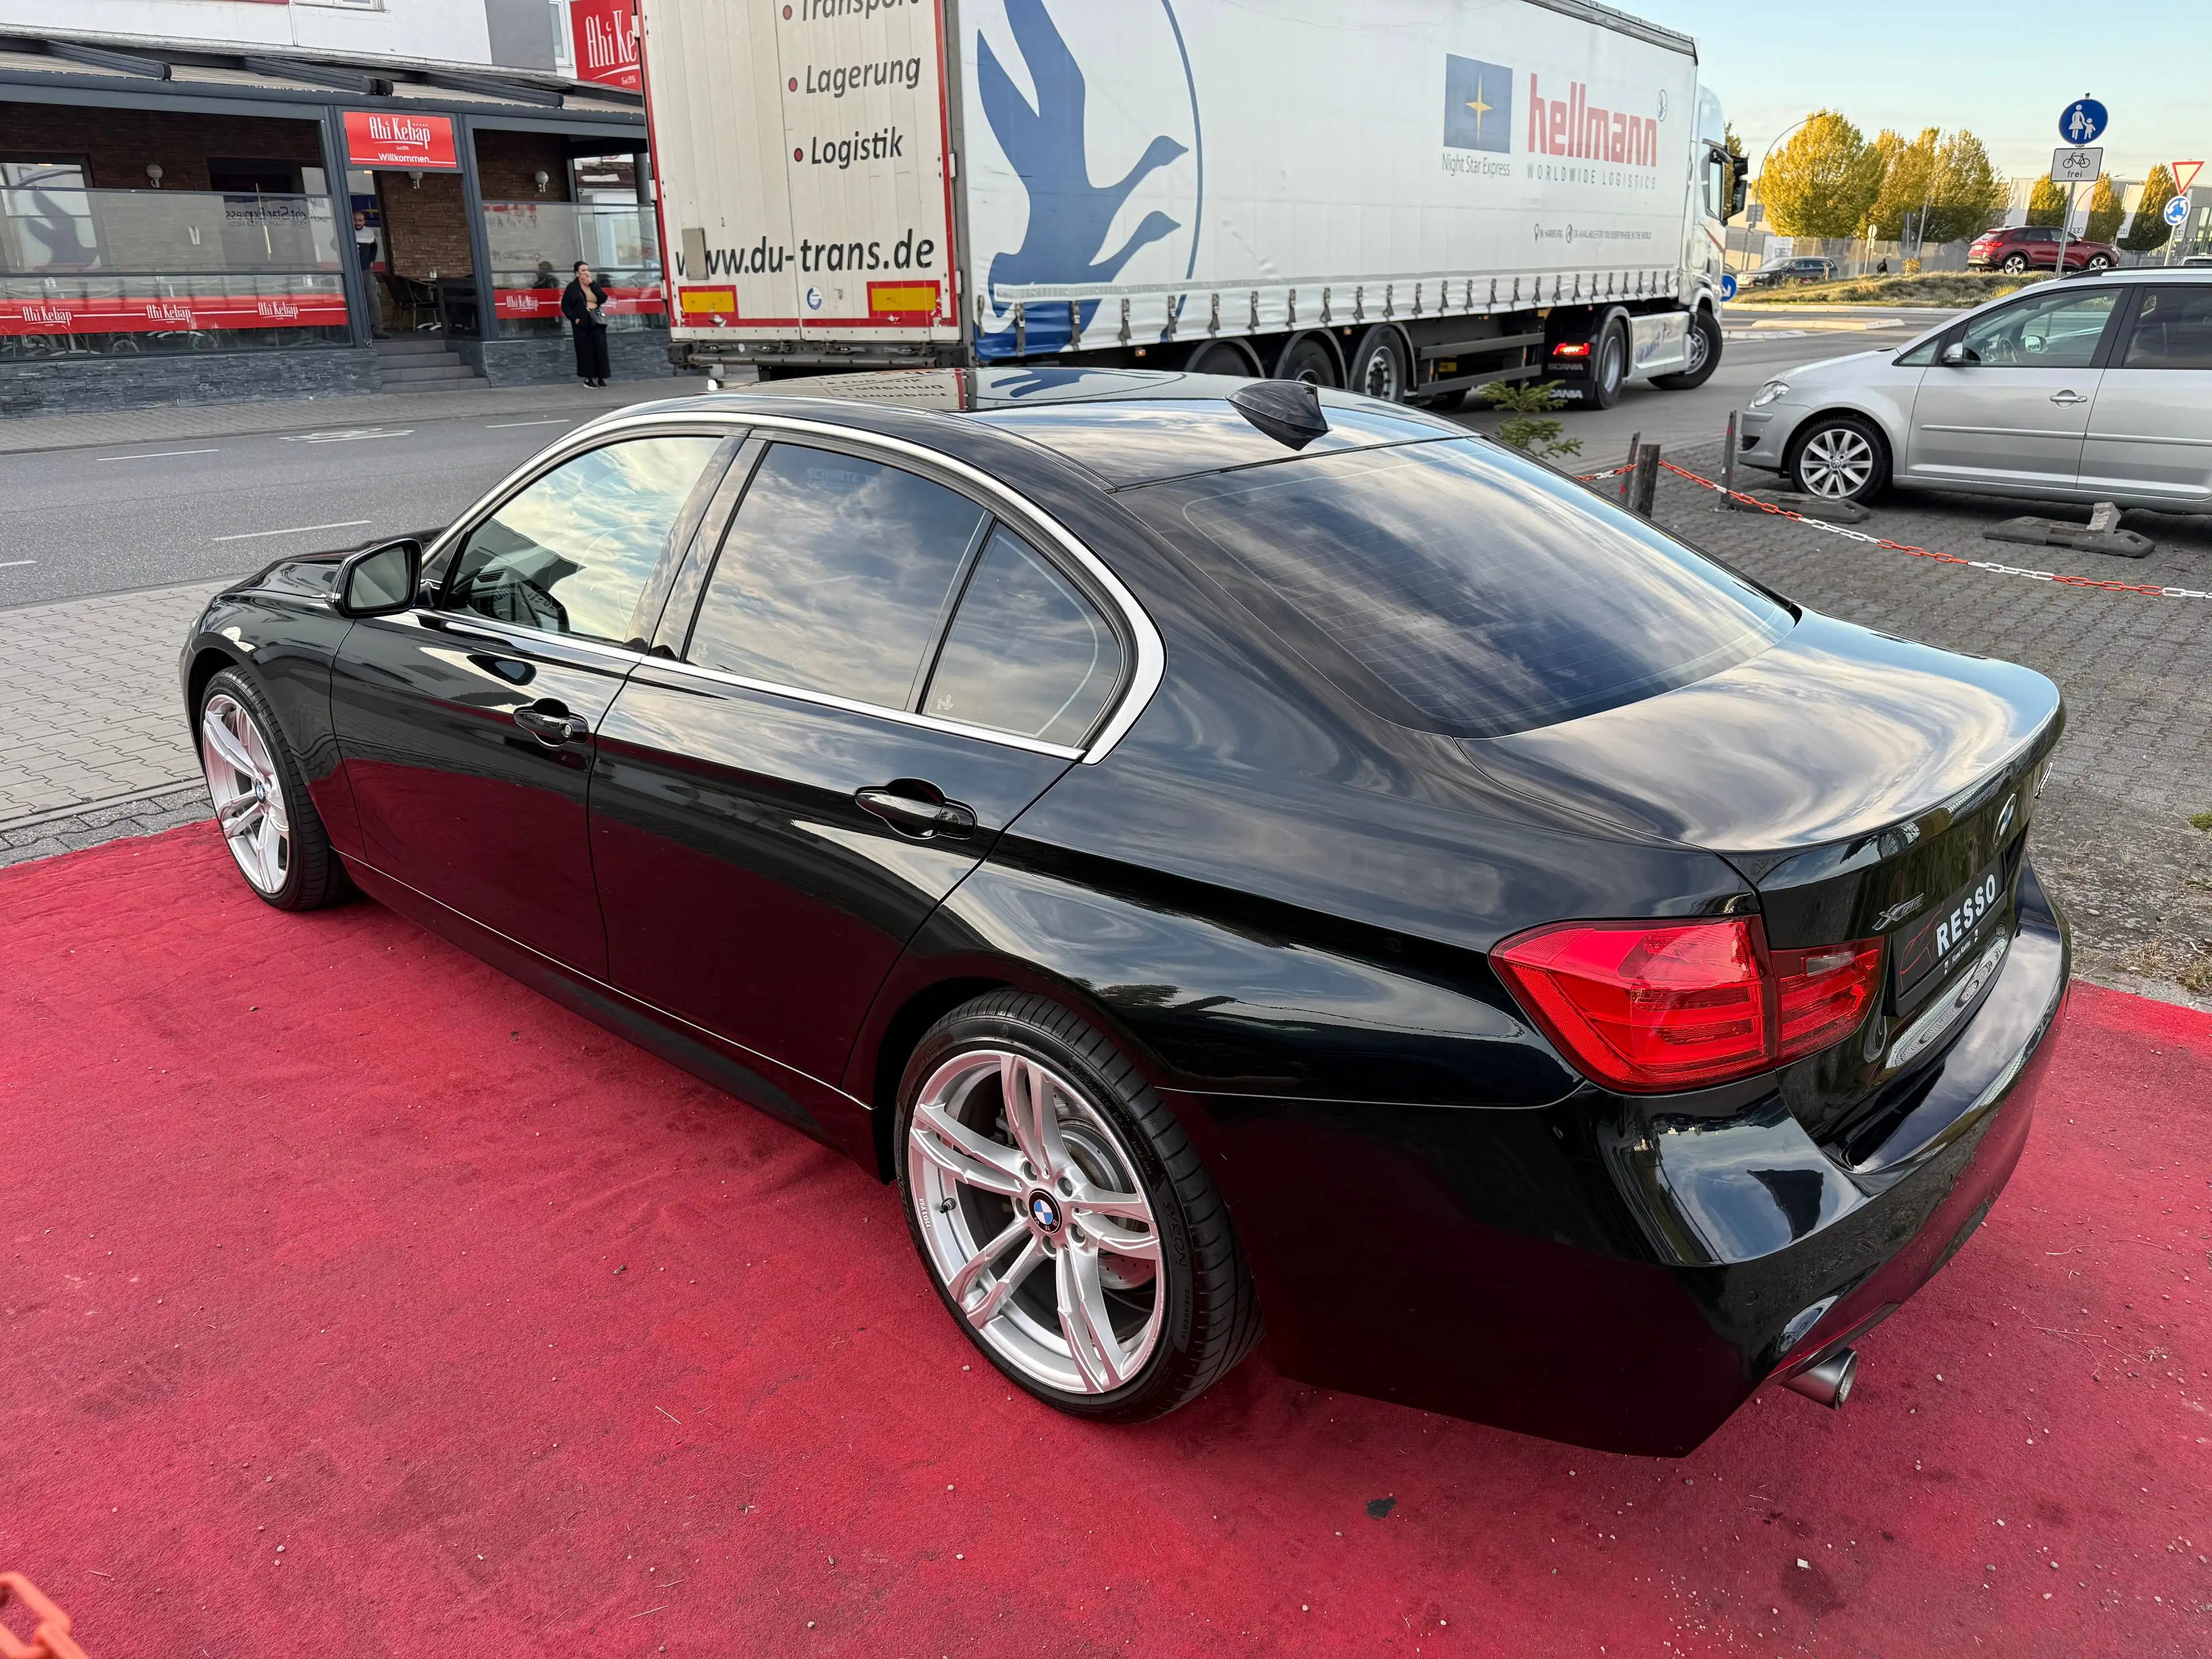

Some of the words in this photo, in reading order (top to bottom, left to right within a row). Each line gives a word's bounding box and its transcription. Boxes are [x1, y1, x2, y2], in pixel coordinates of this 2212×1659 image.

[802, 0, 919, 21] Transp
[585, 14, 615, 68] Ahi
[806, 58, 921, 98] Lagerung
[1528, 73, 1657, 168] hellmann
[369, 116, 392, 139] Ahi
[392, 117, 431, 150] Kebap
[378, 153, 430, 163] Willkommen
[812, 126, 903, 169] Logistik
[1442, 153, 1464, 176] Night
[1465, 157, 1481, 174] Star
[1482, 157, 1510, 180] Express
[1527, 163, 1596, 184] WORLDWIDE
[1603, 172, 1656, 190] LOGISTICS
[2067, 170, 2082, 178] frei
[22, 306, 39, 322] Ahi
[41, 306, 72, 326] Kebap
[146, 304, 162, 319] Ahi
[164, 304, 191, 323] Kebap
[257, 302, 272, 316] Ahi
[273, 301, 298, 319] Kebap
[1547, 363, 1584, 371] SCANIA
[1548, 389, 1584, 399] CANIA
[1936, 874, 1995, 957] RESSO
